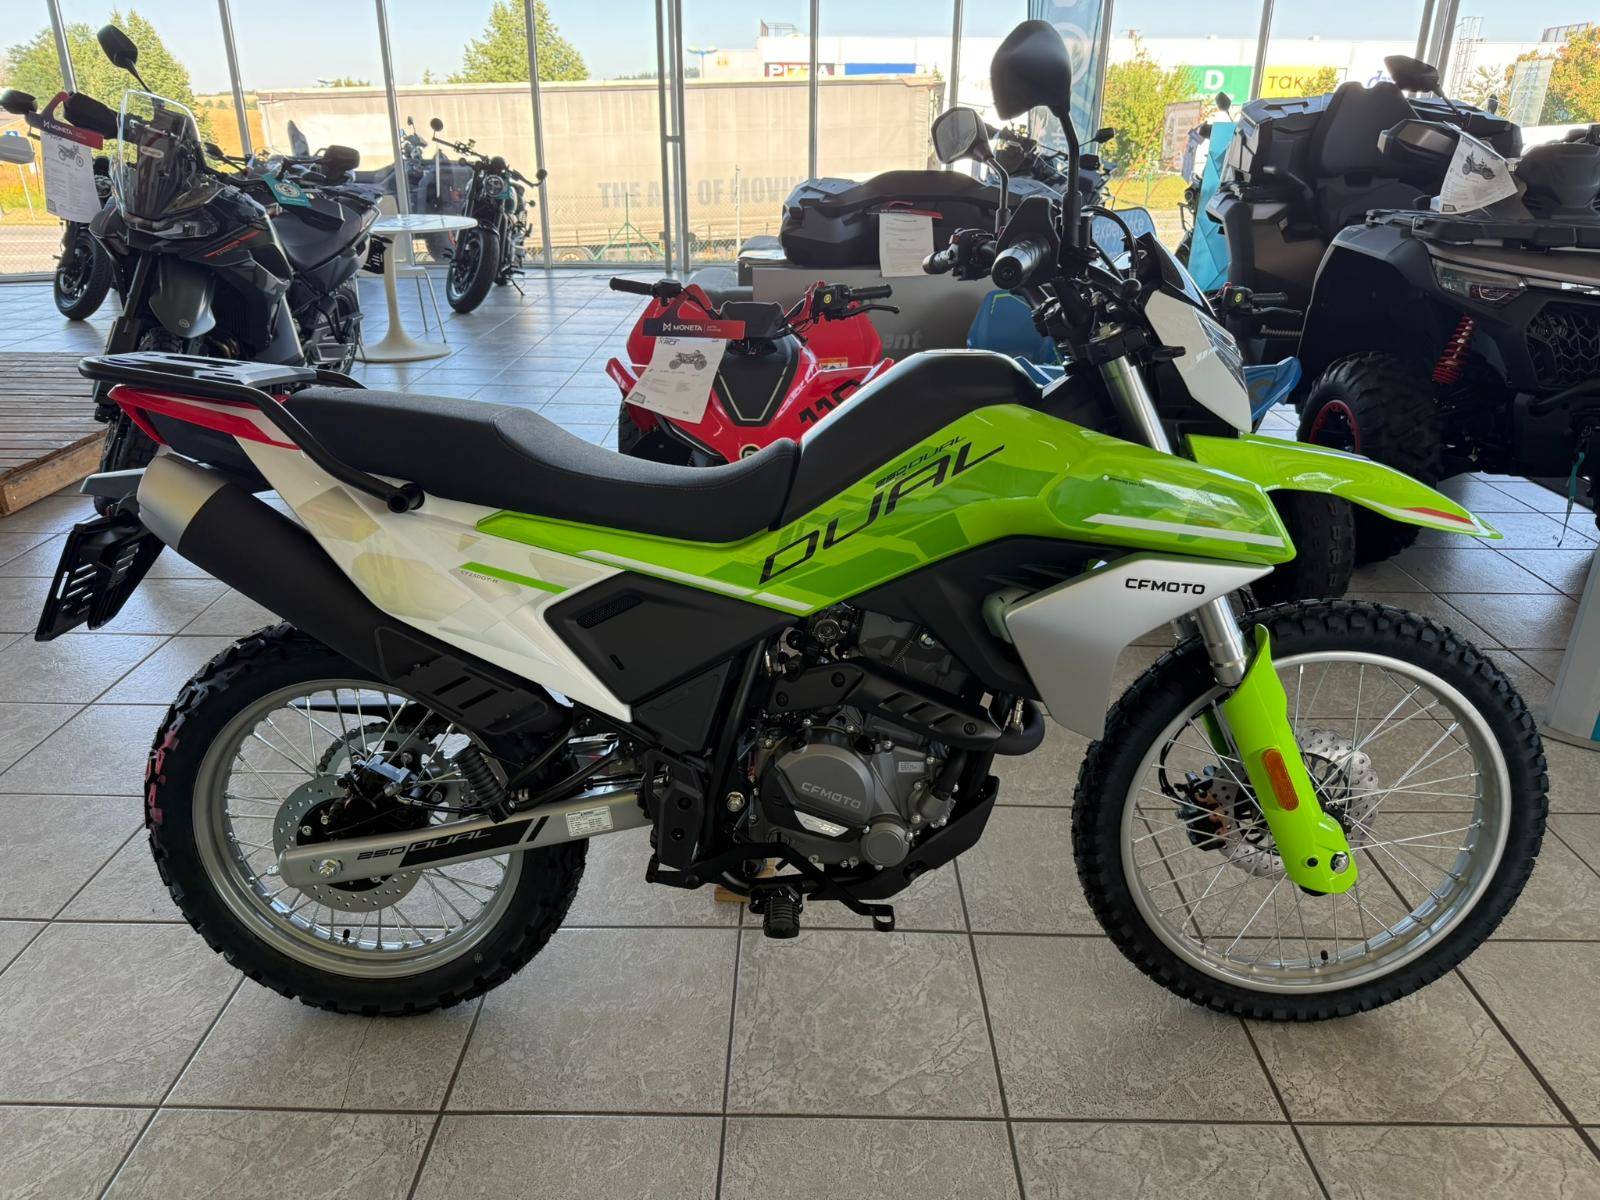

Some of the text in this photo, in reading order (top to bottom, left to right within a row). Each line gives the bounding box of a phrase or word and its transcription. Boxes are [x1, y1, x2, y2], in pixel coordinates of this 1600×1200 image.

[1204, 70, 1225, 90] D
[597, 181, 641, 208] THE
[697, 178, 726, 206] OF
[673, 323, 703, 332] MONETA
[758, 441, 1006, 585] DUAL
[1125, 578, 1205, 595] CFMOTO
[801, 781, 862, 809] CFMOTO
